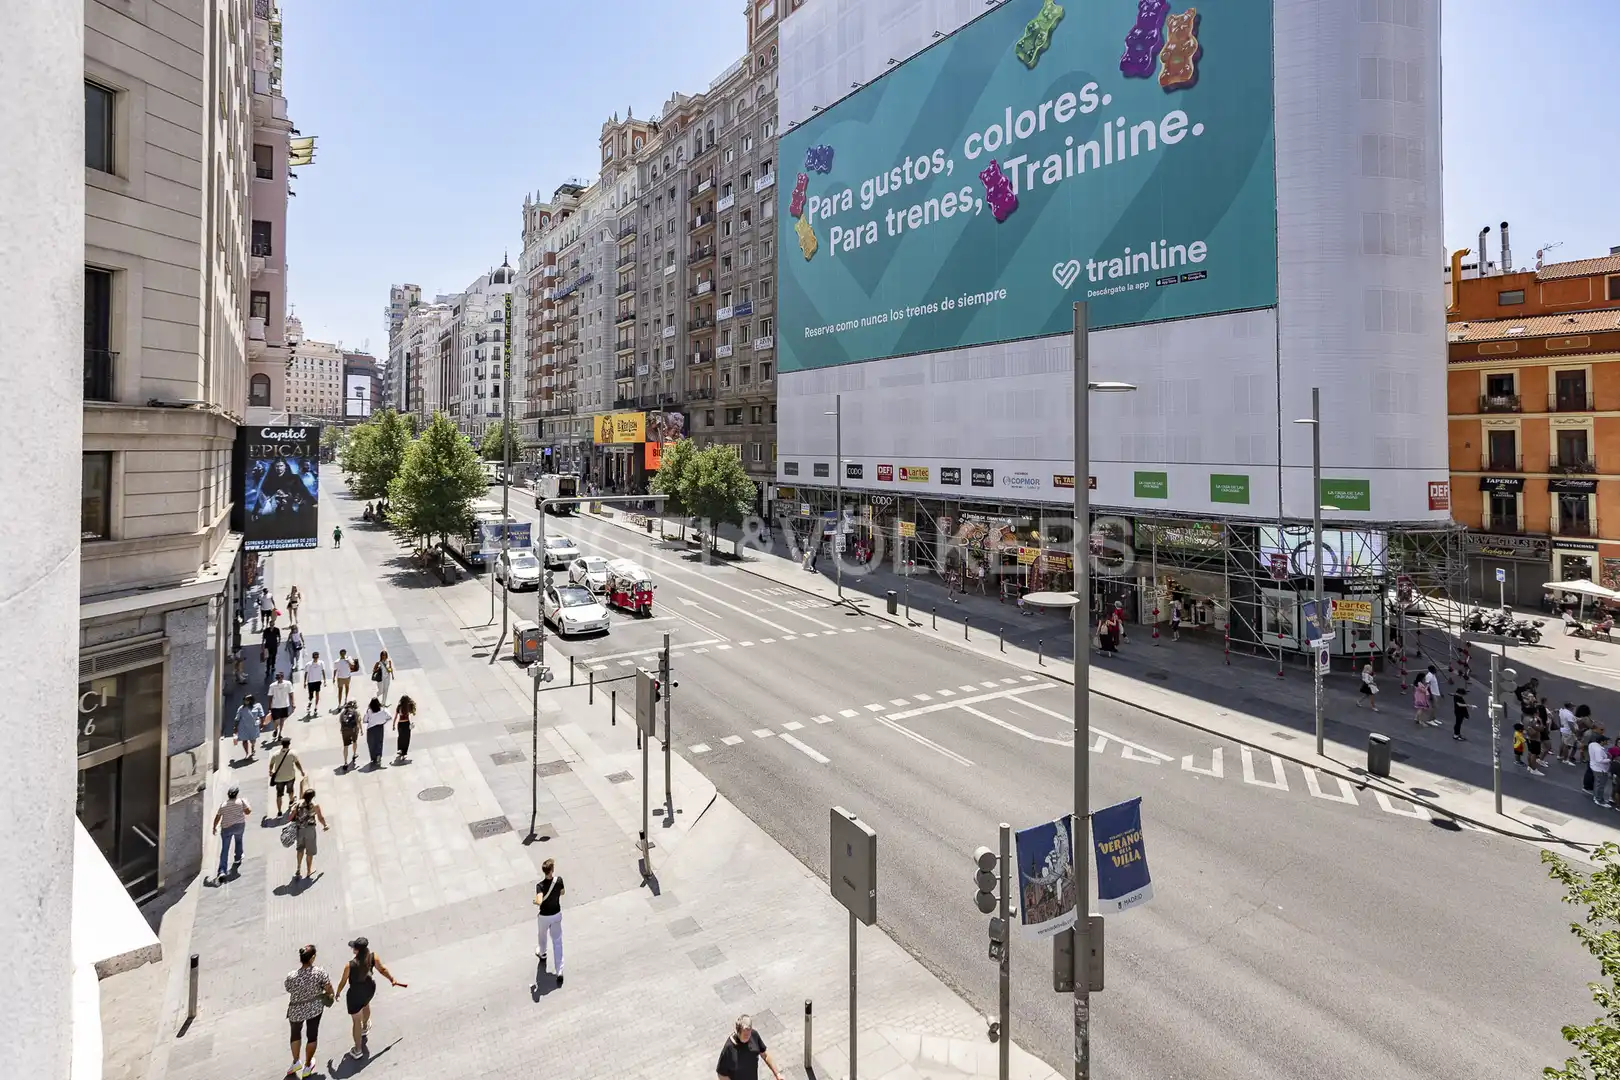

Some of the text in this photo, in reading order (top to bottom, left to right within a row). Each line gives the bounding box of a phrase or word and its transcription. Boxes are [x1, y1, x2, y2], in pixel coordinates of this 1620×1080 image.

[807, 80, 1112, 225] Para gustos, colores.
[829, 109, 1205, 256] Para trenes, Trainline.
[1086, 239, 1208, 282] trainline
[1087, 281, 1150, 298] Descárgate la app
[804, 288, 1007, 338] Reserva como nunca los trenes de siempre
[261, 428, 307, 441] Capitol
[908, 469, 929, 477] Lartec
[1011, 478, 1040, 486] COPMOR
[1339, 601, 1371, 611] Lartec
[1098, 831, 1143, 854] VERANOS
[1111, 849, 1142, 868] VILLA
